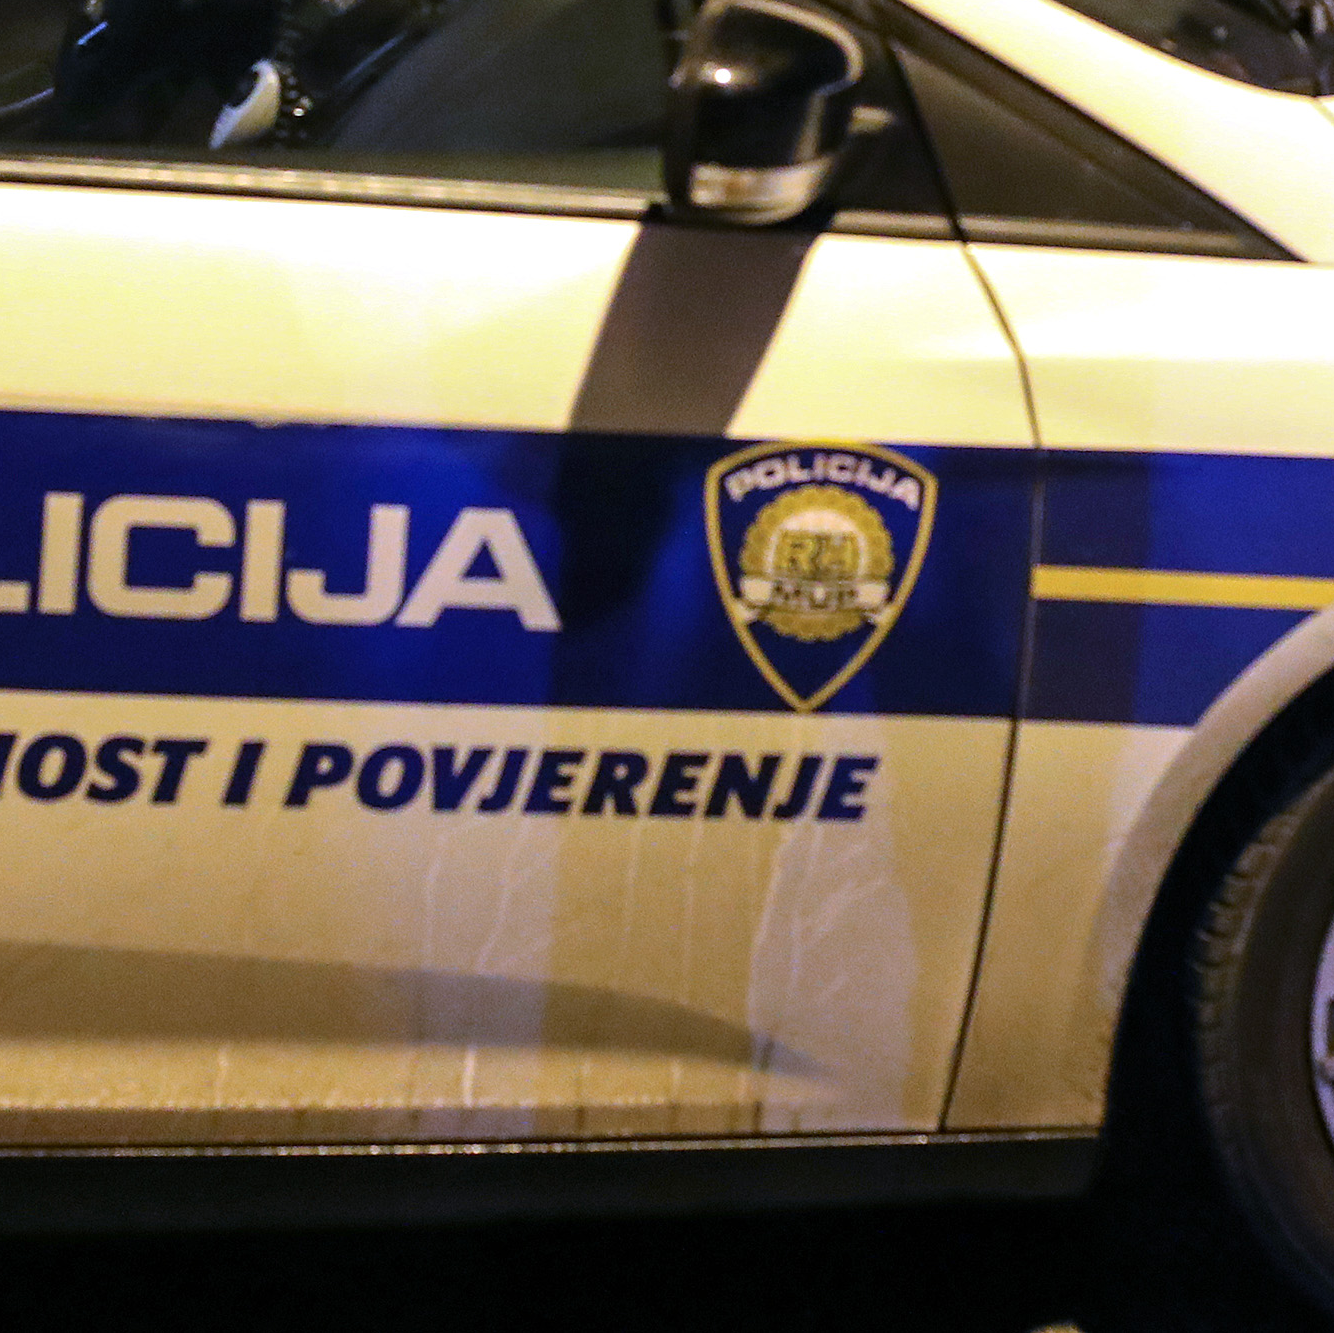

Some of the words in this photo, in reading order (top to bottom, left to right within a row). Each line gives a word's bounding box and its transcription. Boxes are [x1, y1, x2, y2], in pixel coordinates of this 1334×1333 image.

[723, 452, 921, 512] POLICIJA
[221, 740, 267, 808] I
[282, 741, 879, 822] POVJERENJE
